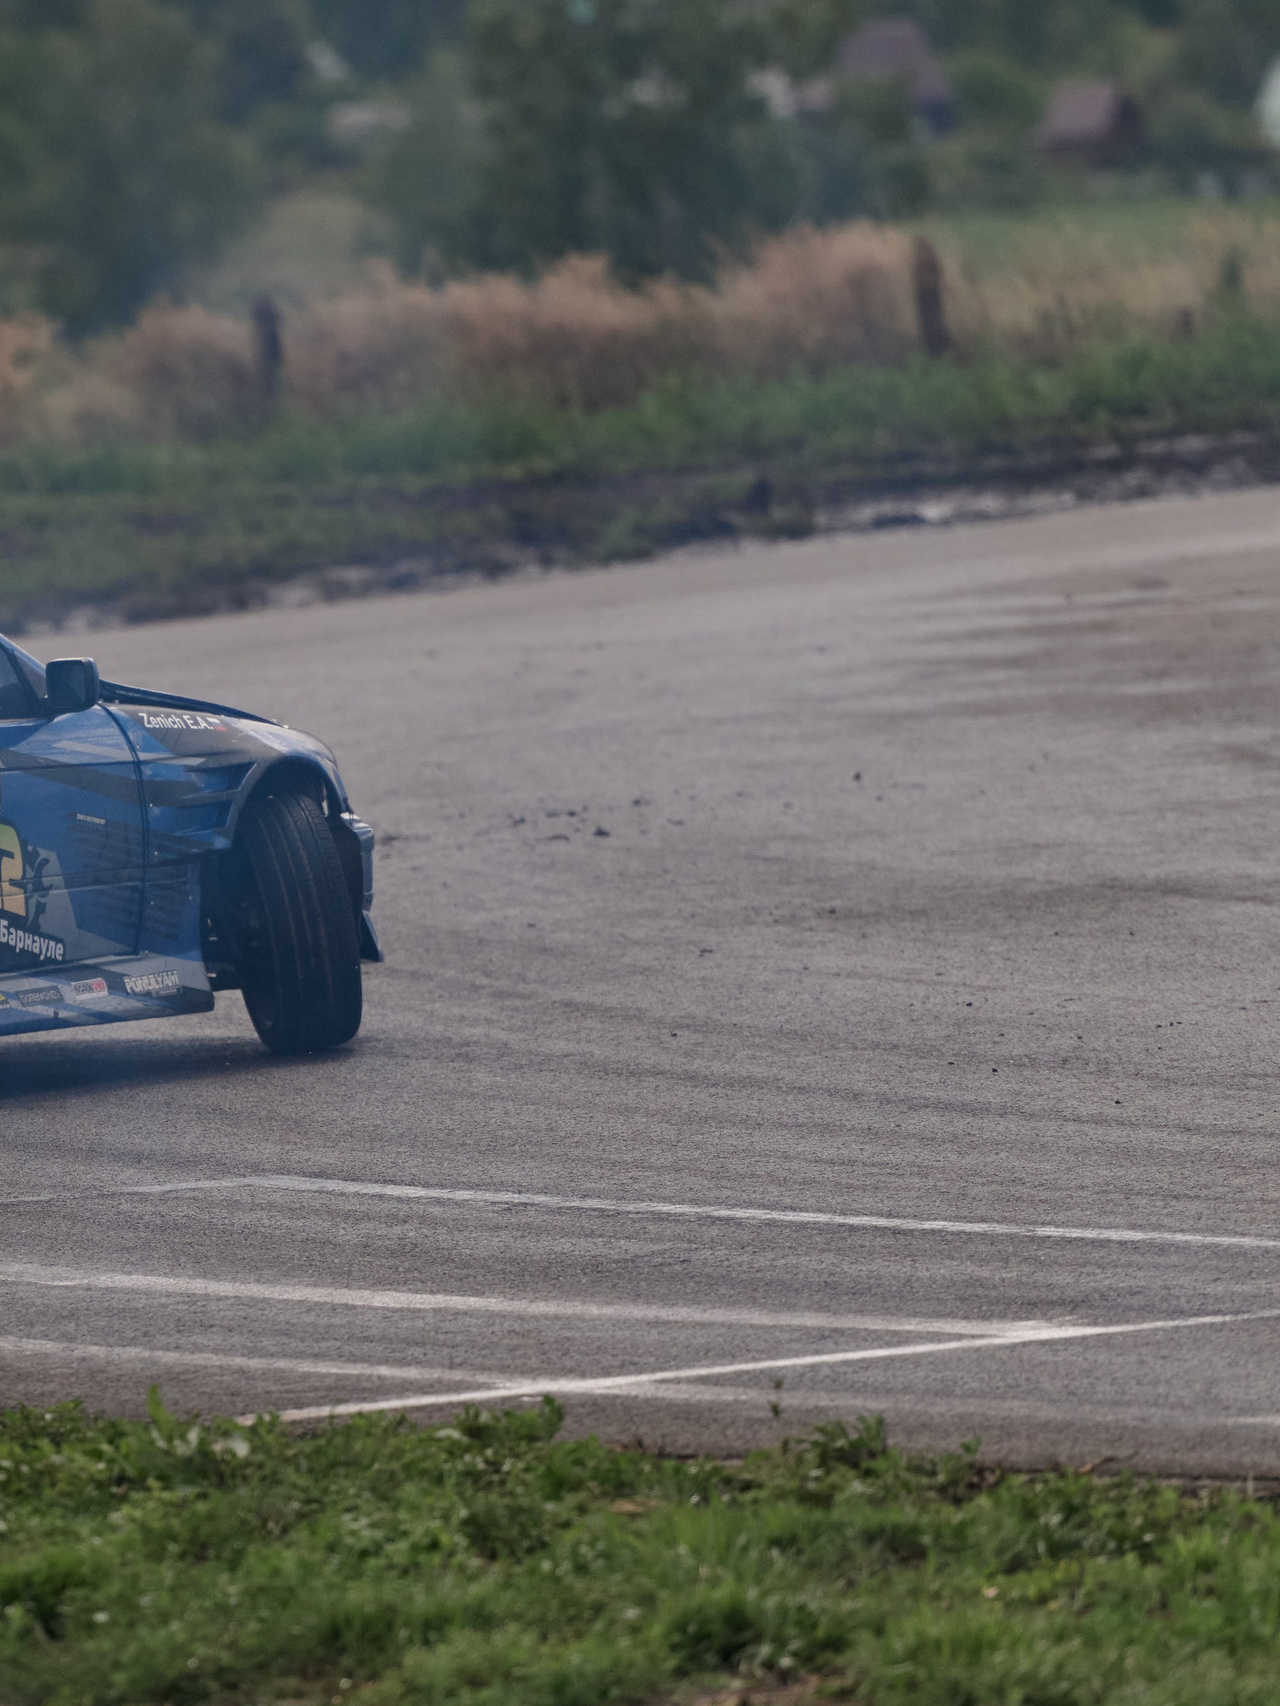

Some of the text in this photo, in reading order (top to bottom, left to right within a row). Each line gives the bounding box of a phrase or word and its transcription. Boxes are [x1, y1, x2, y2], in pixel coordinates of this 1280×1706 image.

[138, 713, 214, 730] Zenich E.A.
[0, 919, 64, 961] Барнауле
